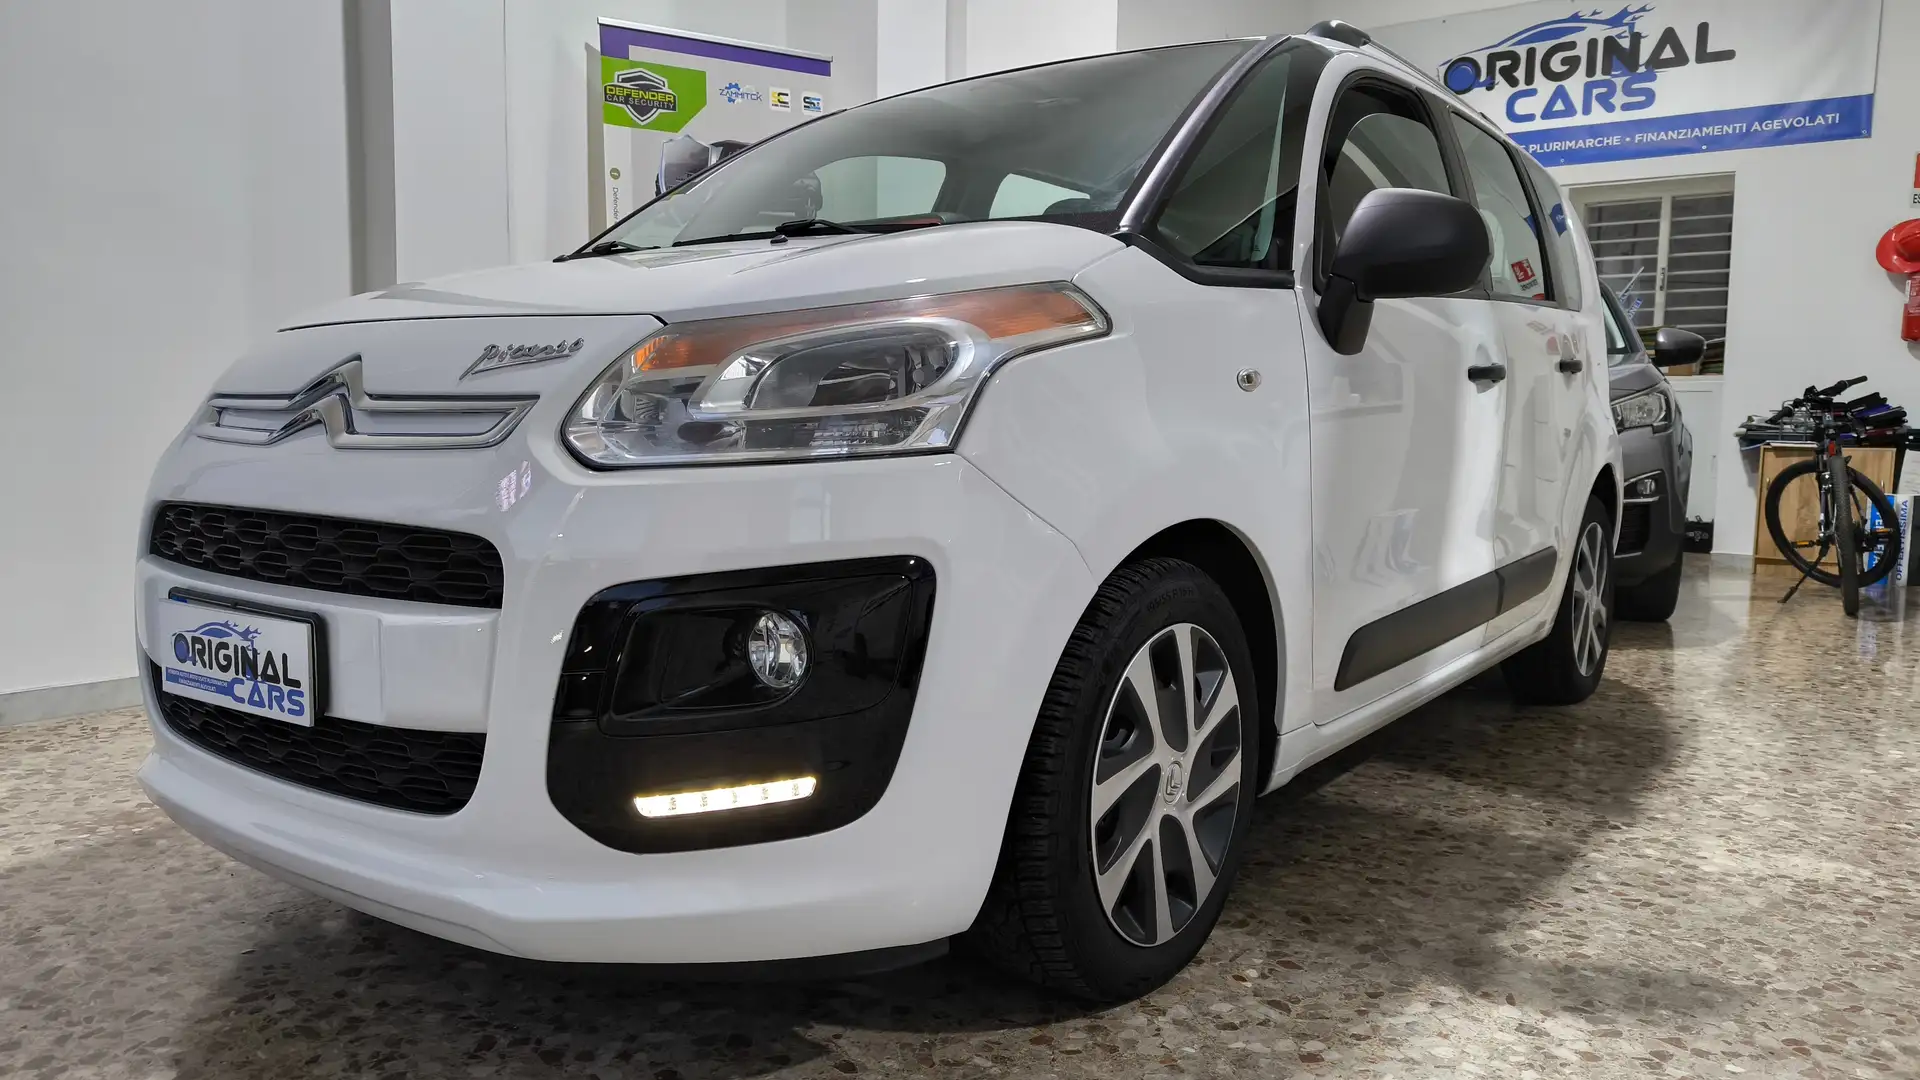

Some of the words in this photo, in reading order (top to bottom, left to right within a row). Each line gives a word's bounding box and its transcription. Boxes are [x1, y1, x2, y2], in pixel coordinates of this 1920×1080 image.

[1443, 22, 1736, 94] ORIGINAL
[606, 86, 674, 102] DEFENDER
[606, 94, 625, 103] CAR
[628, 97, 674, 109] SECURITY
[1505, 73, 1657, 124] CARS
[1529, 135, 1621, 153] PLURIMARCHE
[1635, 123, 1747, 143] FINANZIAMENTI
[1750, 113, 1840, 132] AGEVOLATI
[612, 187, 620, 219] Defender
[173, 633, 301, 688] ORIGINAL
[229, 677, 305, 717] CARS
